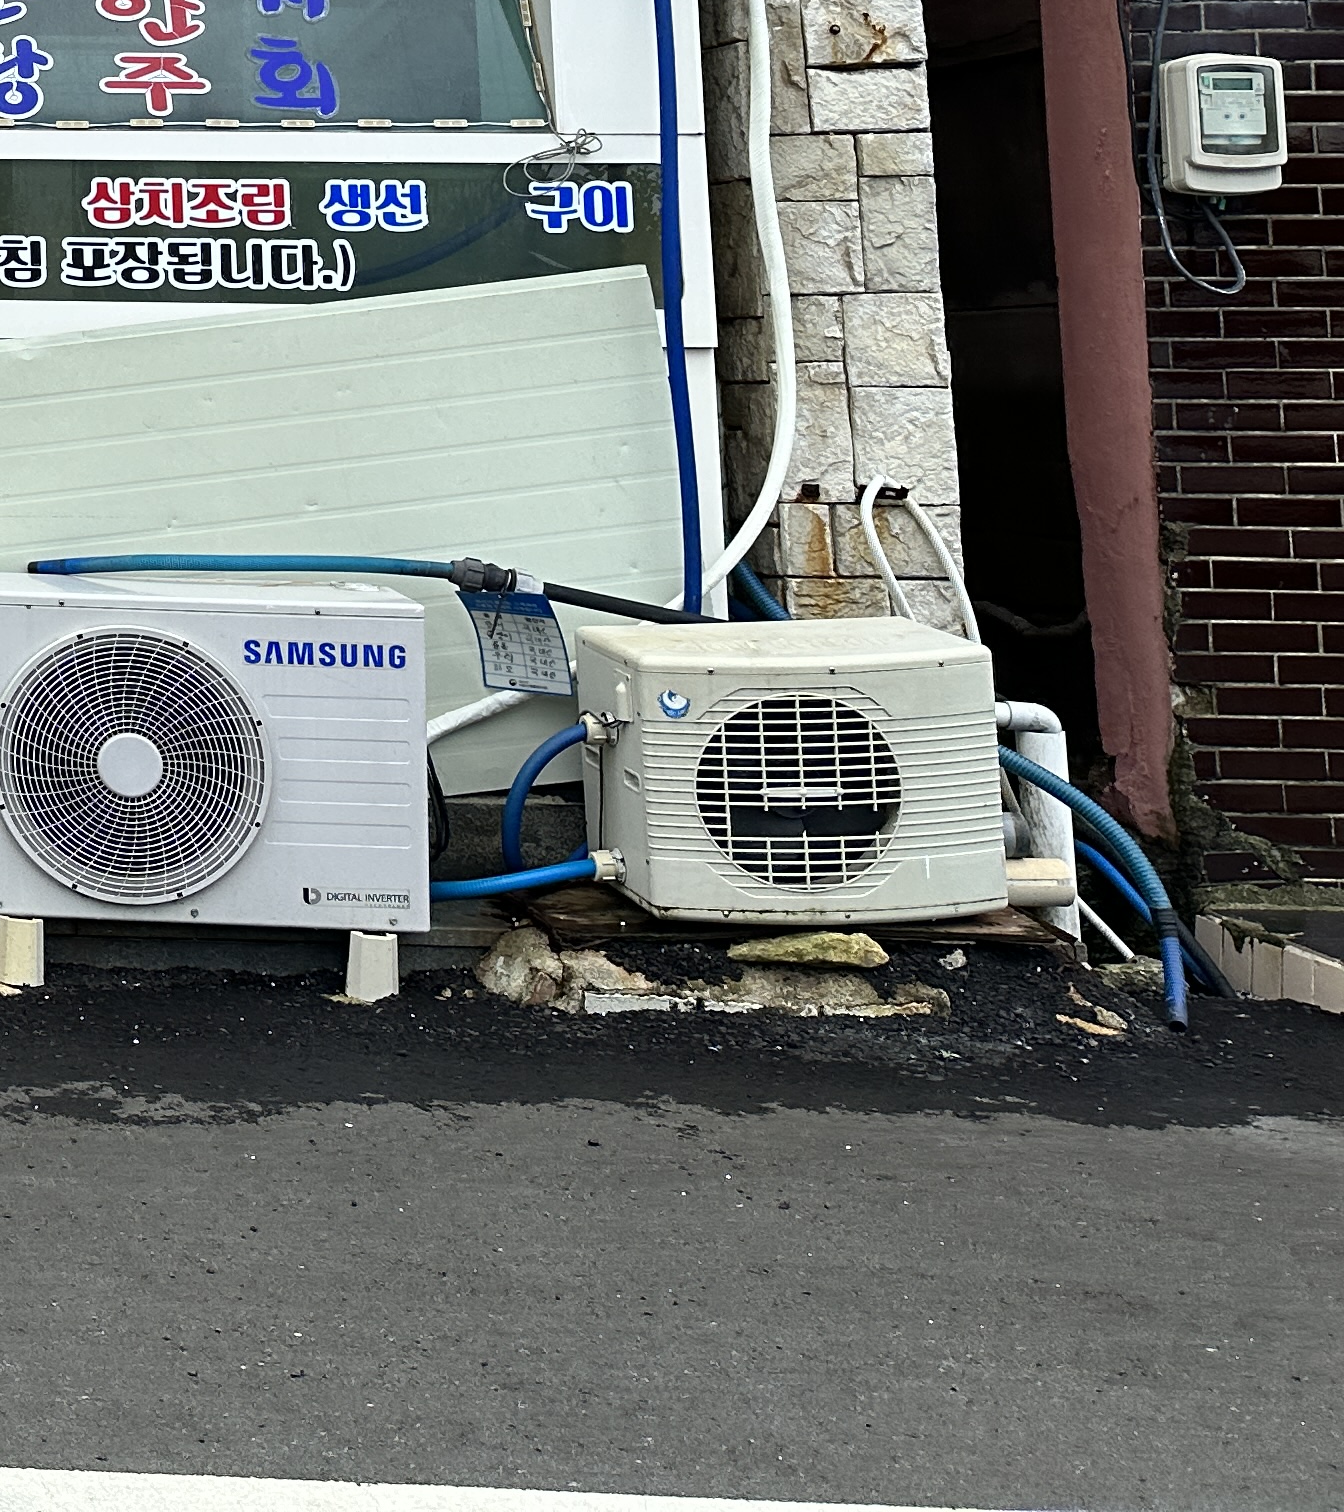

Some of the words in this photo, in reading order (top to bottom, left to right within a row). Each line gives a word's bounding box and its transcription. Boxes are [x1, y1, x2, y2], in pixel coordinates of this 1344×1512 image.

[82, 176, 294, 231] 삼치조림
[317, 178, 430, 232] 생선
[524, 178, 636, 234] 구이
[59, 236, 357, 291] 포장됩니다.)
[243, 639, 407, 670] SAMSUNG
[326, 892, 362, 902] DIGITAL
[365, 893, 410, 904] INVERTER
